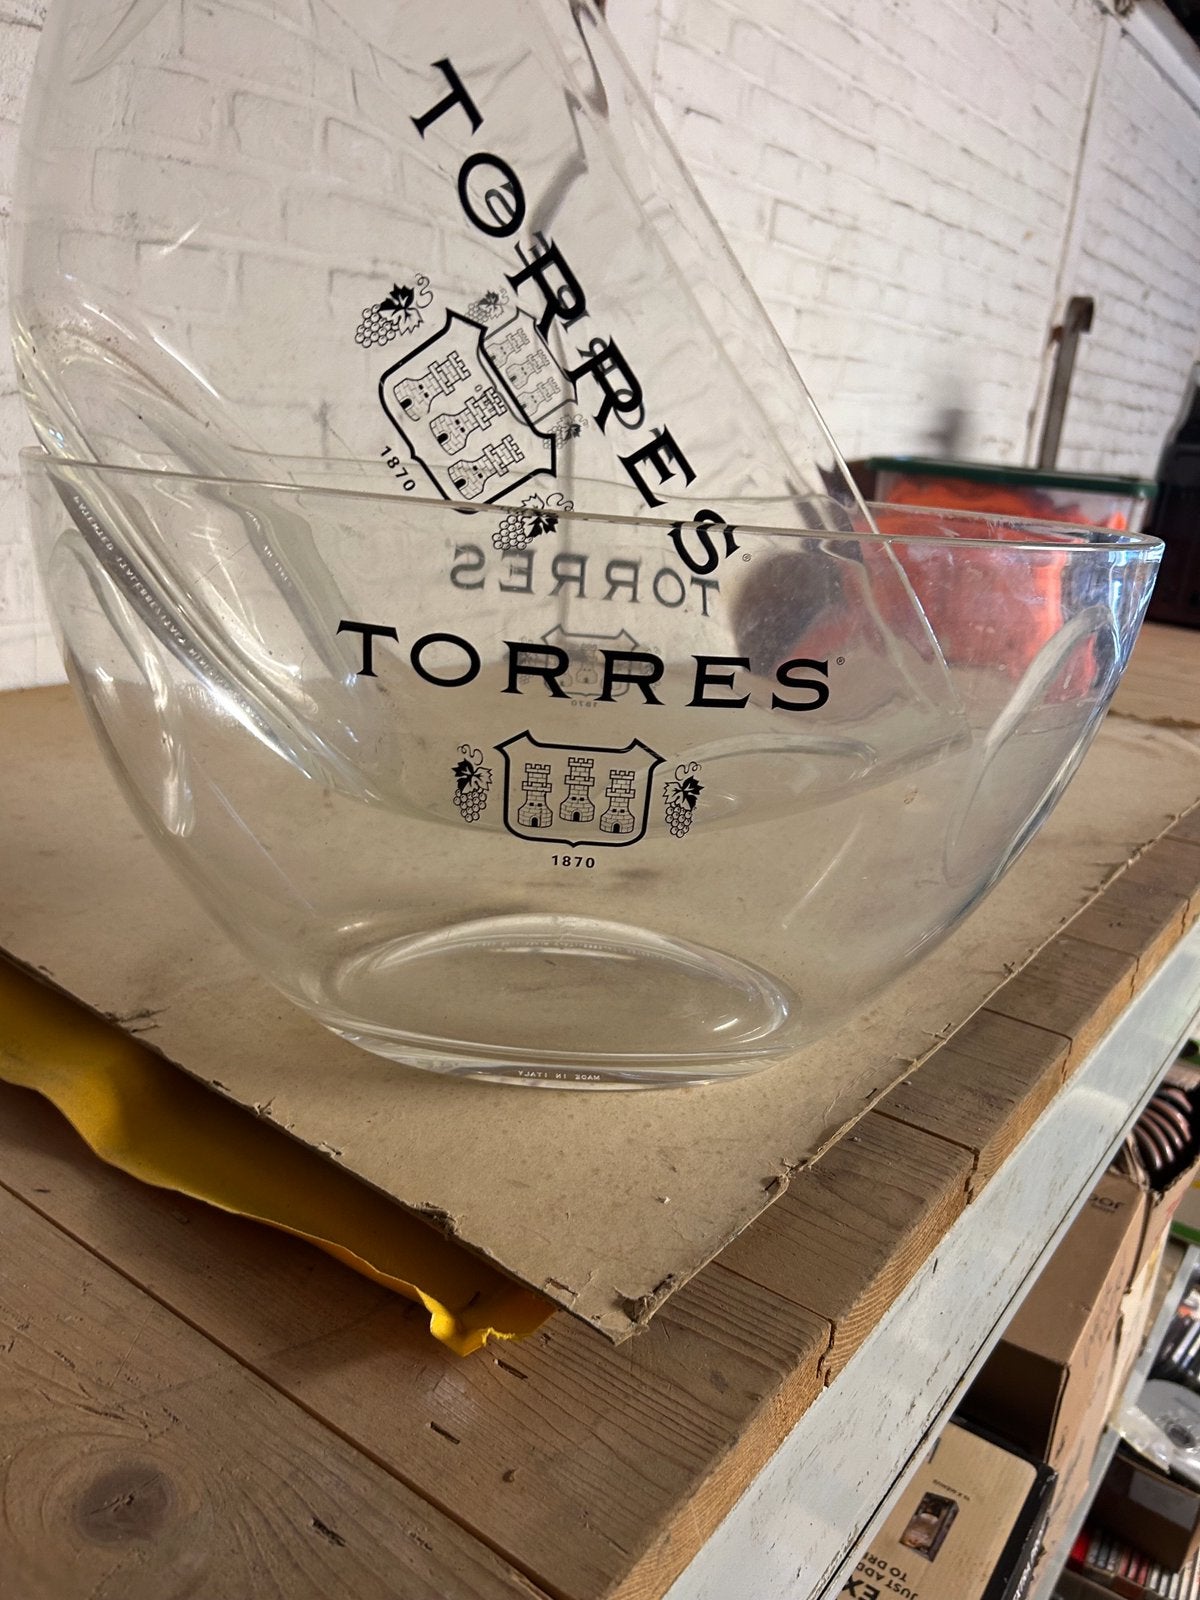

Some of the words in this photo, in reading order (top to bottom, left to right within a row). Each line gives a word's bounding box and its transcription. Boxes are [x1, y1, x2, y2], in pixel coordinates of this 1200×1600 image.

[410, 57, 741, 575] TORRES
[381, 445, 416, 492] 1870
[336, 620, 831, 712] TORRES
[551, 854, 596, 869] 1870
[885, 1579, 919, 1600] JUST
[889, 1567, 908, 1583] TO
